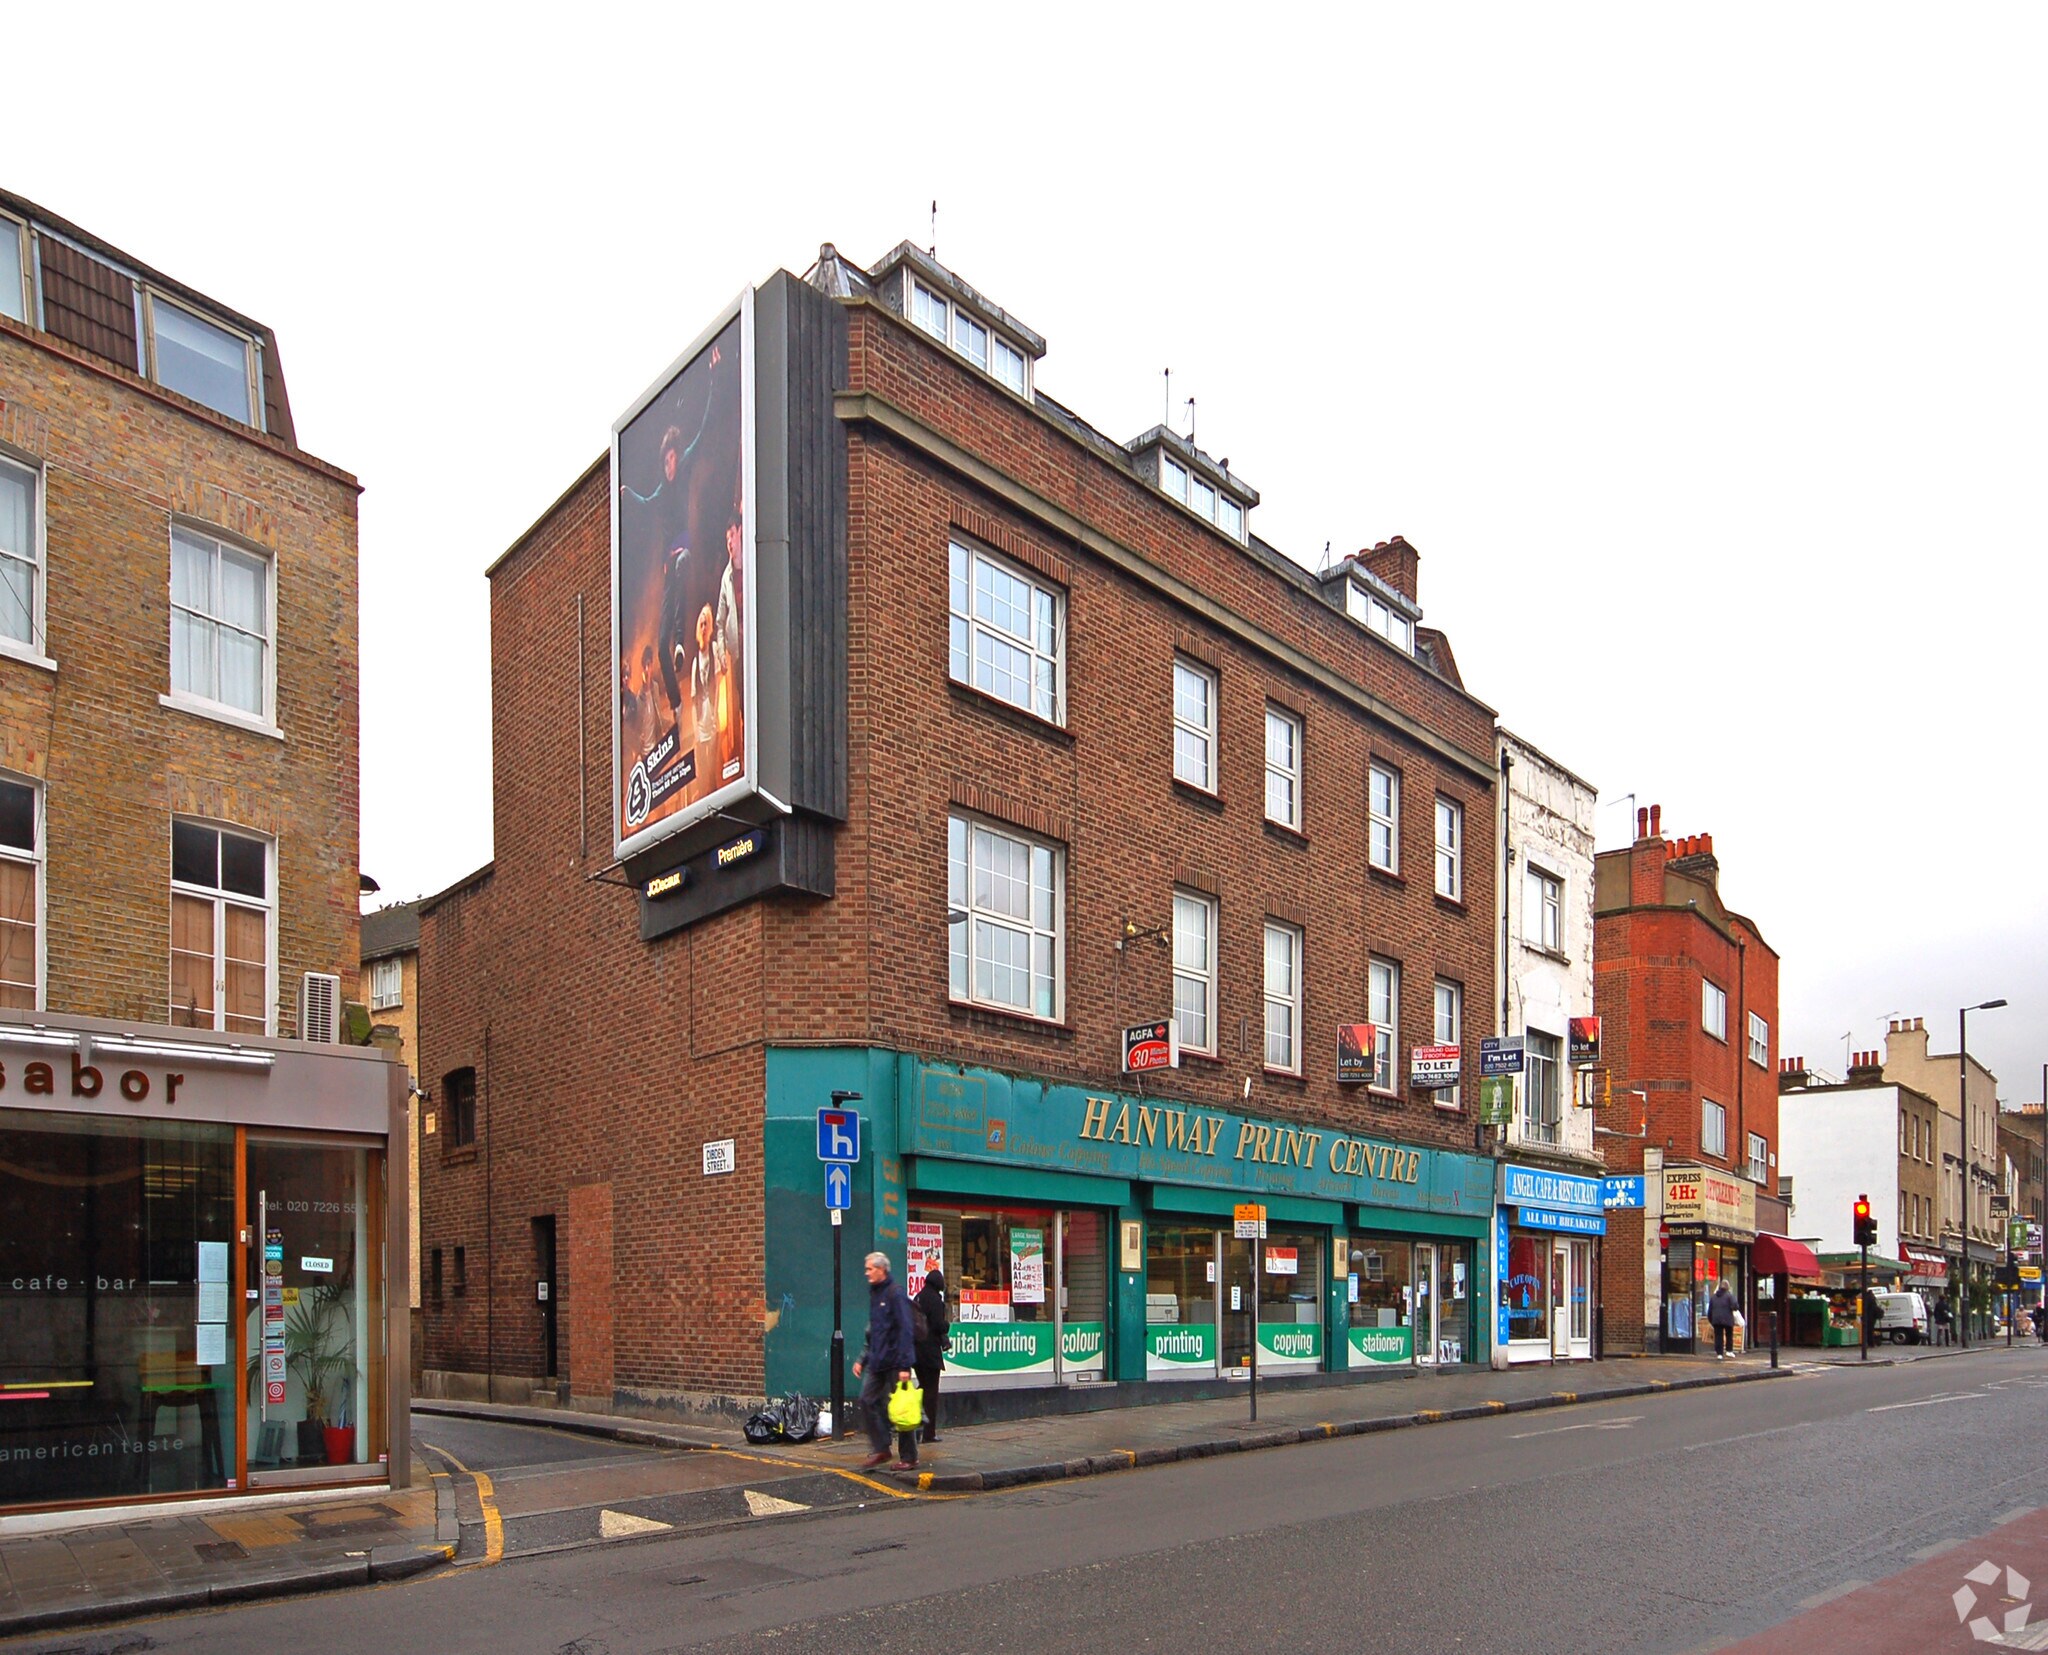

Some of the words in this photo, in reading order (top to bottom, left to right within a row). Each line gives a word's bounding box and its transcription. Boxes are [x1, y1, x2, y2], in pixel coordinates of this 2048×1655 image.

[1129, 1028, 1153, 1042] AGFA
[1484, 1041, 1498, 1049] CITY
[1580, 1043, 1589, 1051] let
[1132, 1049, 1149, 1068] 30
[1148, 1056, 1168, 1066] Photos
[1340, 1058, 1352, 1066] Let
[1354, 1058, 1363, 1068] by
[1503, 1053, 1517, 1061] Let
[1417, 1062, 1431, 1070] TO
[1434, 1061, 1453, 1070] LET
[0, 1052, 184, 1104] abor
[1079, 1097, 1225, 1156] HANWAY
[1233, 1122, 1322, 1169] PRINT
[1329, 1138, 1421, 1184] CENTRE
[1009, 1135, 1056, 1159] Colour
[1059, 1144, 1111, 1172] Copying
[706, 1159, 727, 1172] STREET
[1666, 1173, 1702, 1183] EXPRESS
[1511, 1172, 1534, 1196] ANGEL
[1535, 1175, 1552, 1199] CAFE
[1558, 1179, 1598, 1206] RESTAURANT
[1669, 1184, 1697, 1200] 4Hr
[265, 1201, 282, 1211] tel:
[287, 1201, 309, 1212] 020
[313, 1202, 340, 1213] 7226
[1604, 1196, 1635, 1206] OPEN
[1525, 1211, 1541, 1223] ALL
[1542, 1213, 1557, 1225] DAY
[1559, 1214, 1601, 1231] BREAKFAST
[1669, 1227, 1682, 1235] Shirt
[1683, 1227, 1702, 1235] Service
[305, 1261, 330, 1269] CLOSED
[1013, 1262, 1022, 1271] A2
[12, 1275, 68, 1290] cafe
[97, 1275, 136, 1290] bar
[1013, 1271, 1022, 1280] A1
[983, 1331, 1036, 1357] printing
[1062, 1327, 1101, 1353] colour
[1155, 1330, 1203, 1358] printing
[1273, 1329, 1313, 1355] copying
[1362, 1332, 1405, 1355] stationery
[0, 1441, 113, 1462] american
[121, 1437, 184, 1454] taste
